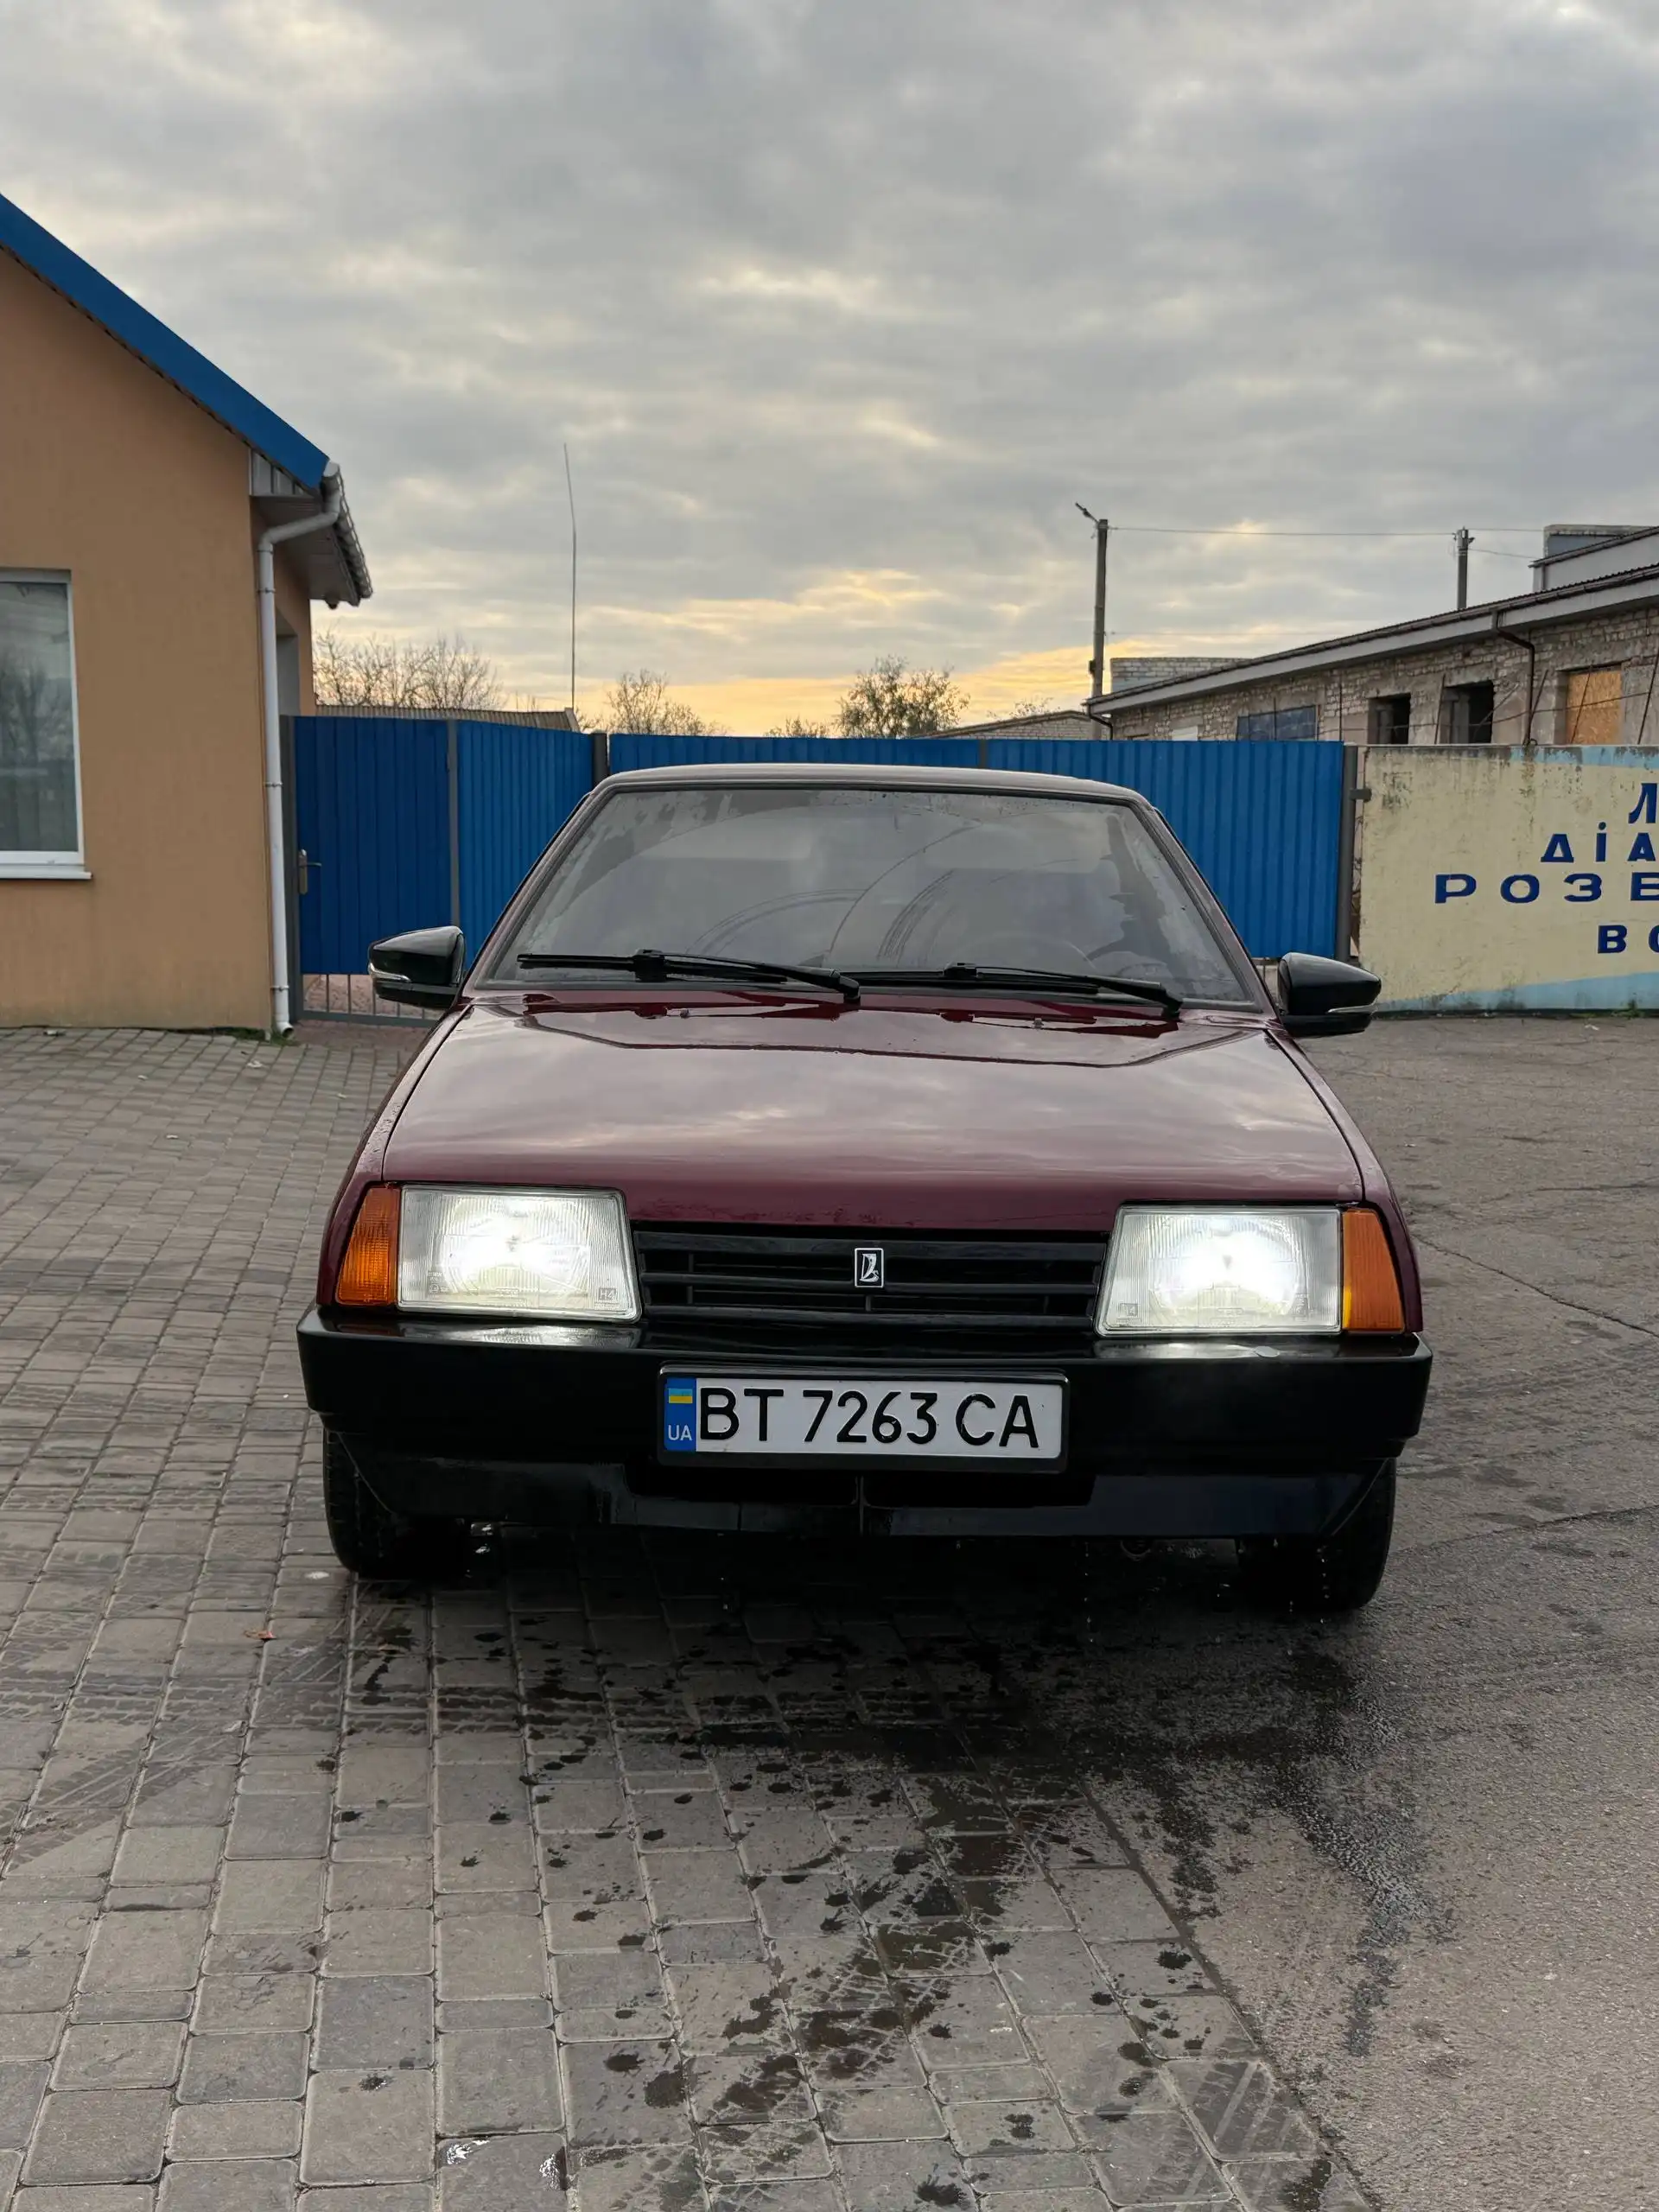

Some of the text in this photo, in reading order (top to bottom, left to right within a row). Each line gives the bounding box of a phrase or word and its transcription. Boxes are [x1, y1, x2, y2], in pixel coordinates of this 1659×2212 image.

[668, 1424, 692, 1441] UA
[700, 1387, 1039, 1448] BT 7263 CA
